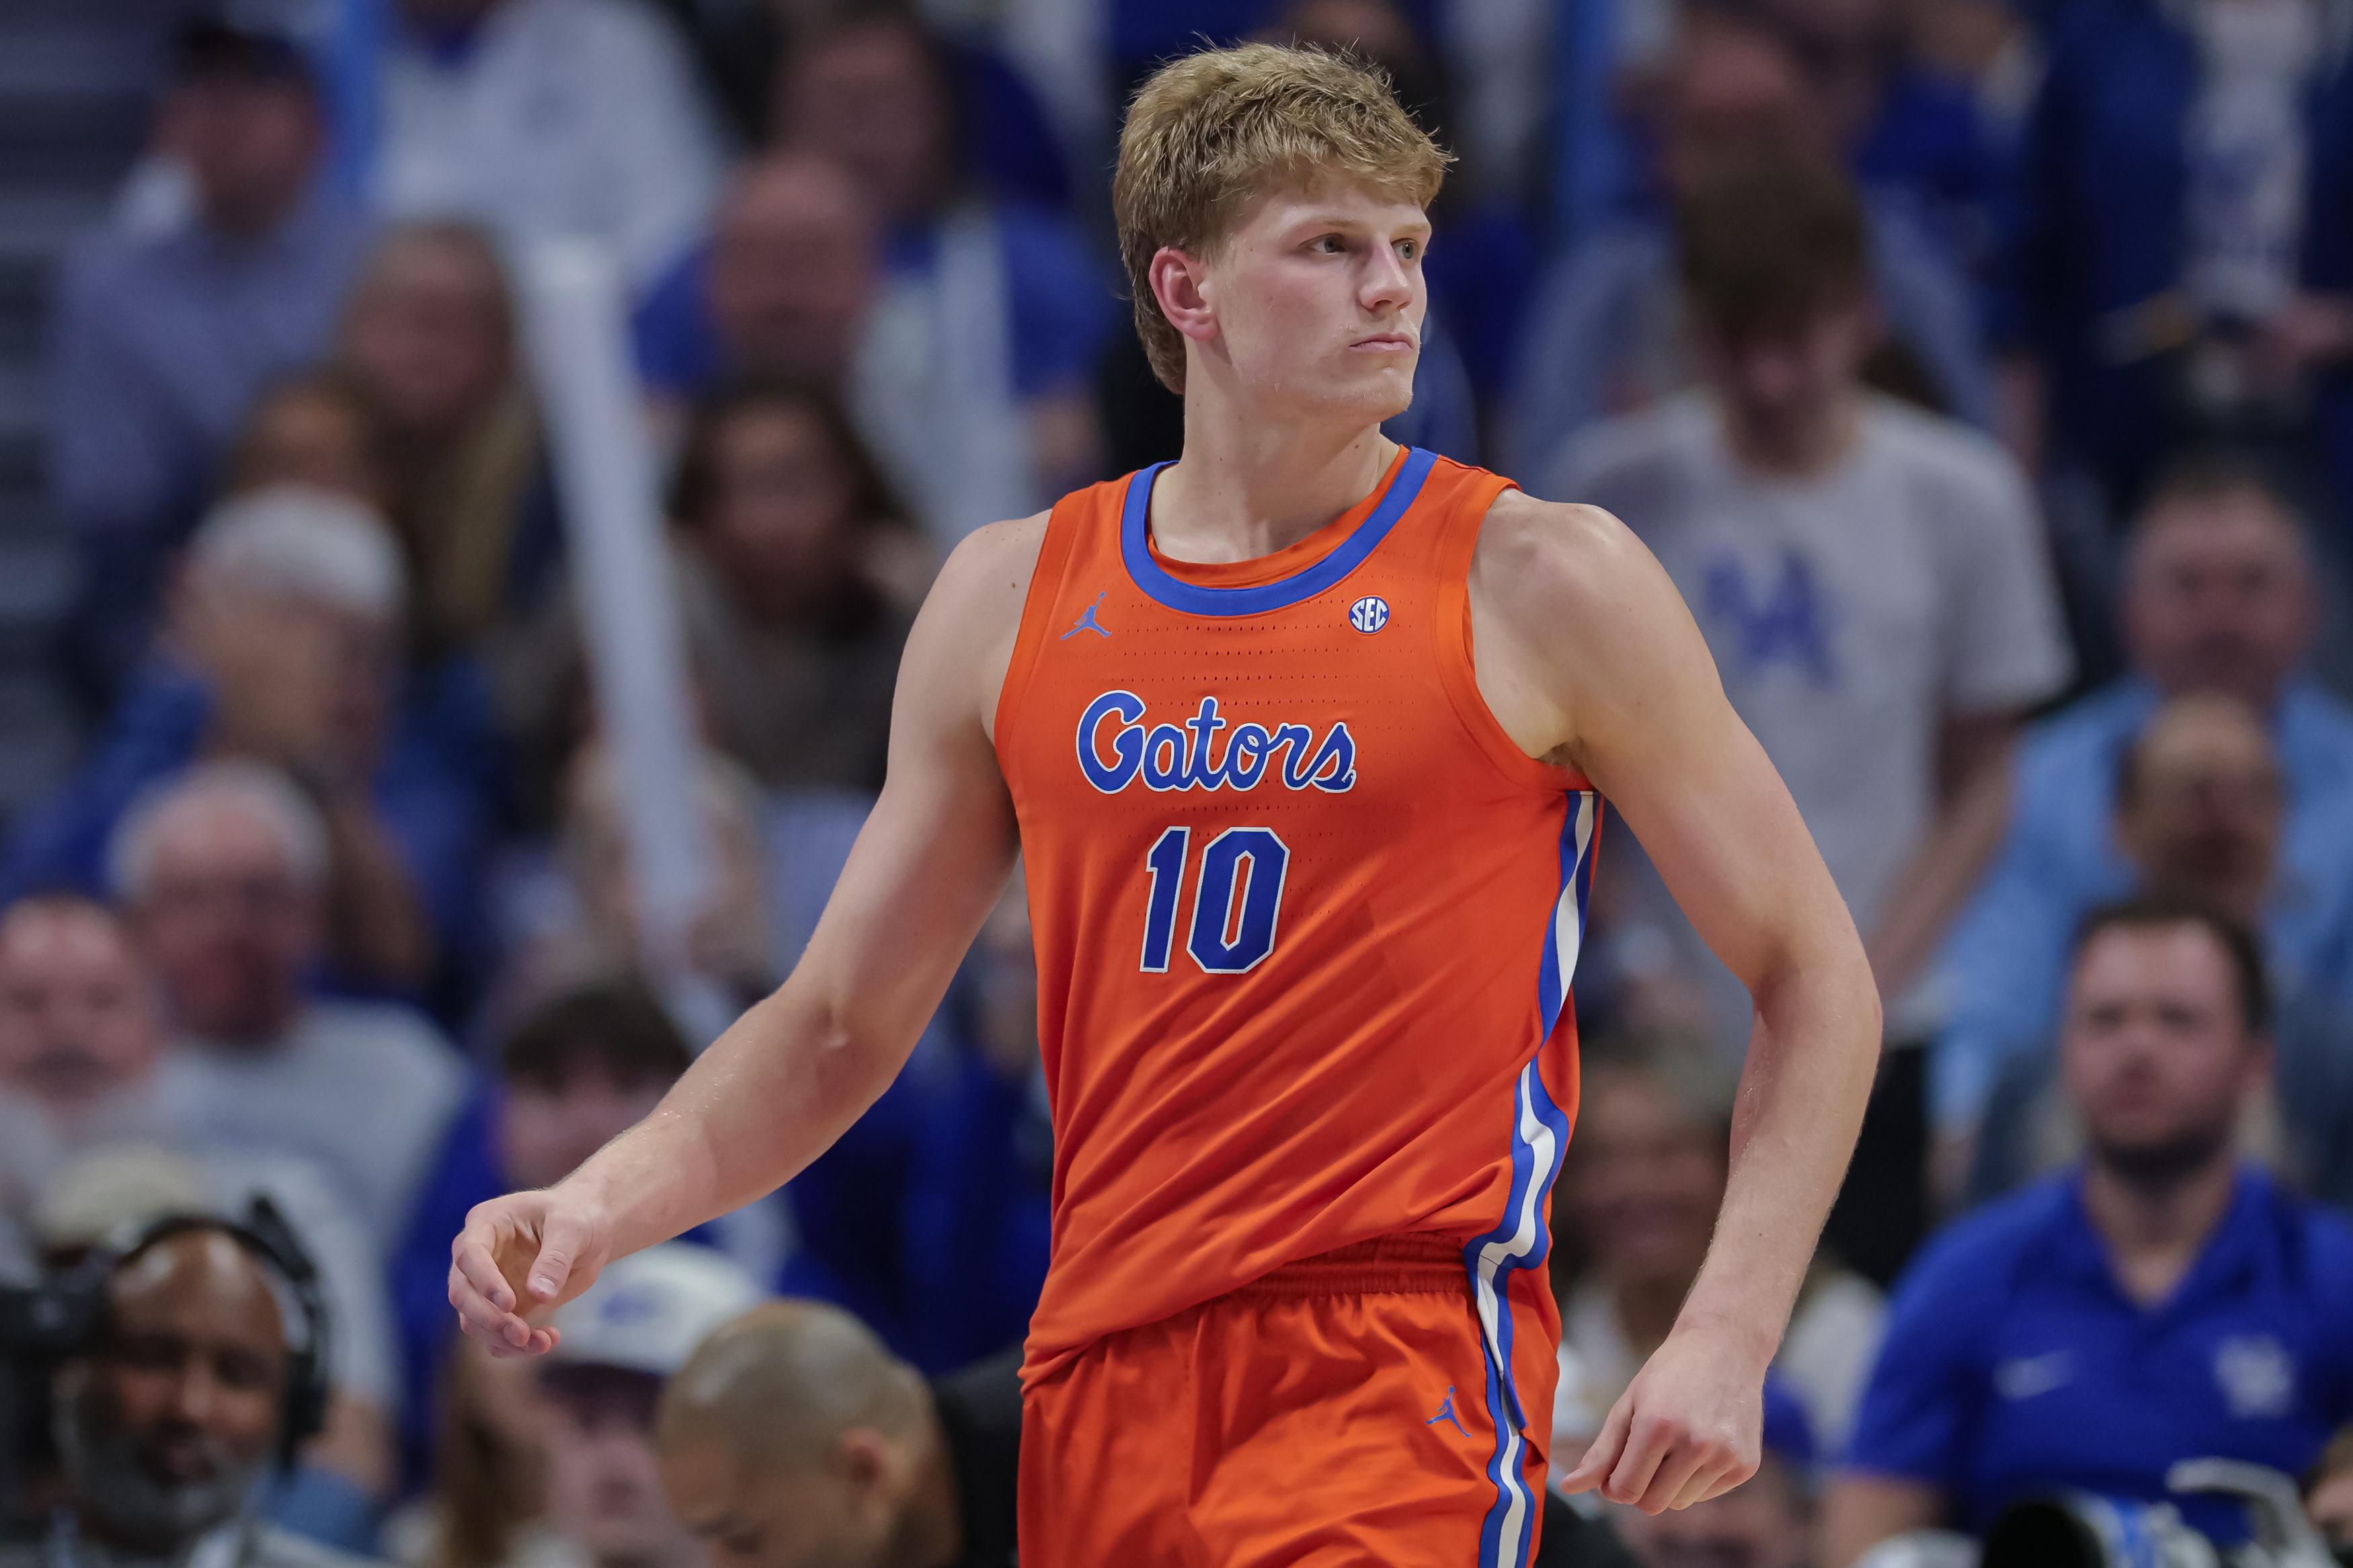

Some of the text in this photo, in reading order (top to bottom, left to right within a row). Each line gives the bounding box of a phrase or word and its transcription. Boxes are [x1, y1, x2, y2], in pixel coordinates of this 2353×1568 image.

[1351, 598, 1388, 632] SEC
[1076, 690, 1356, 794] Gators
[1140, 826, 1290, 974] 10
